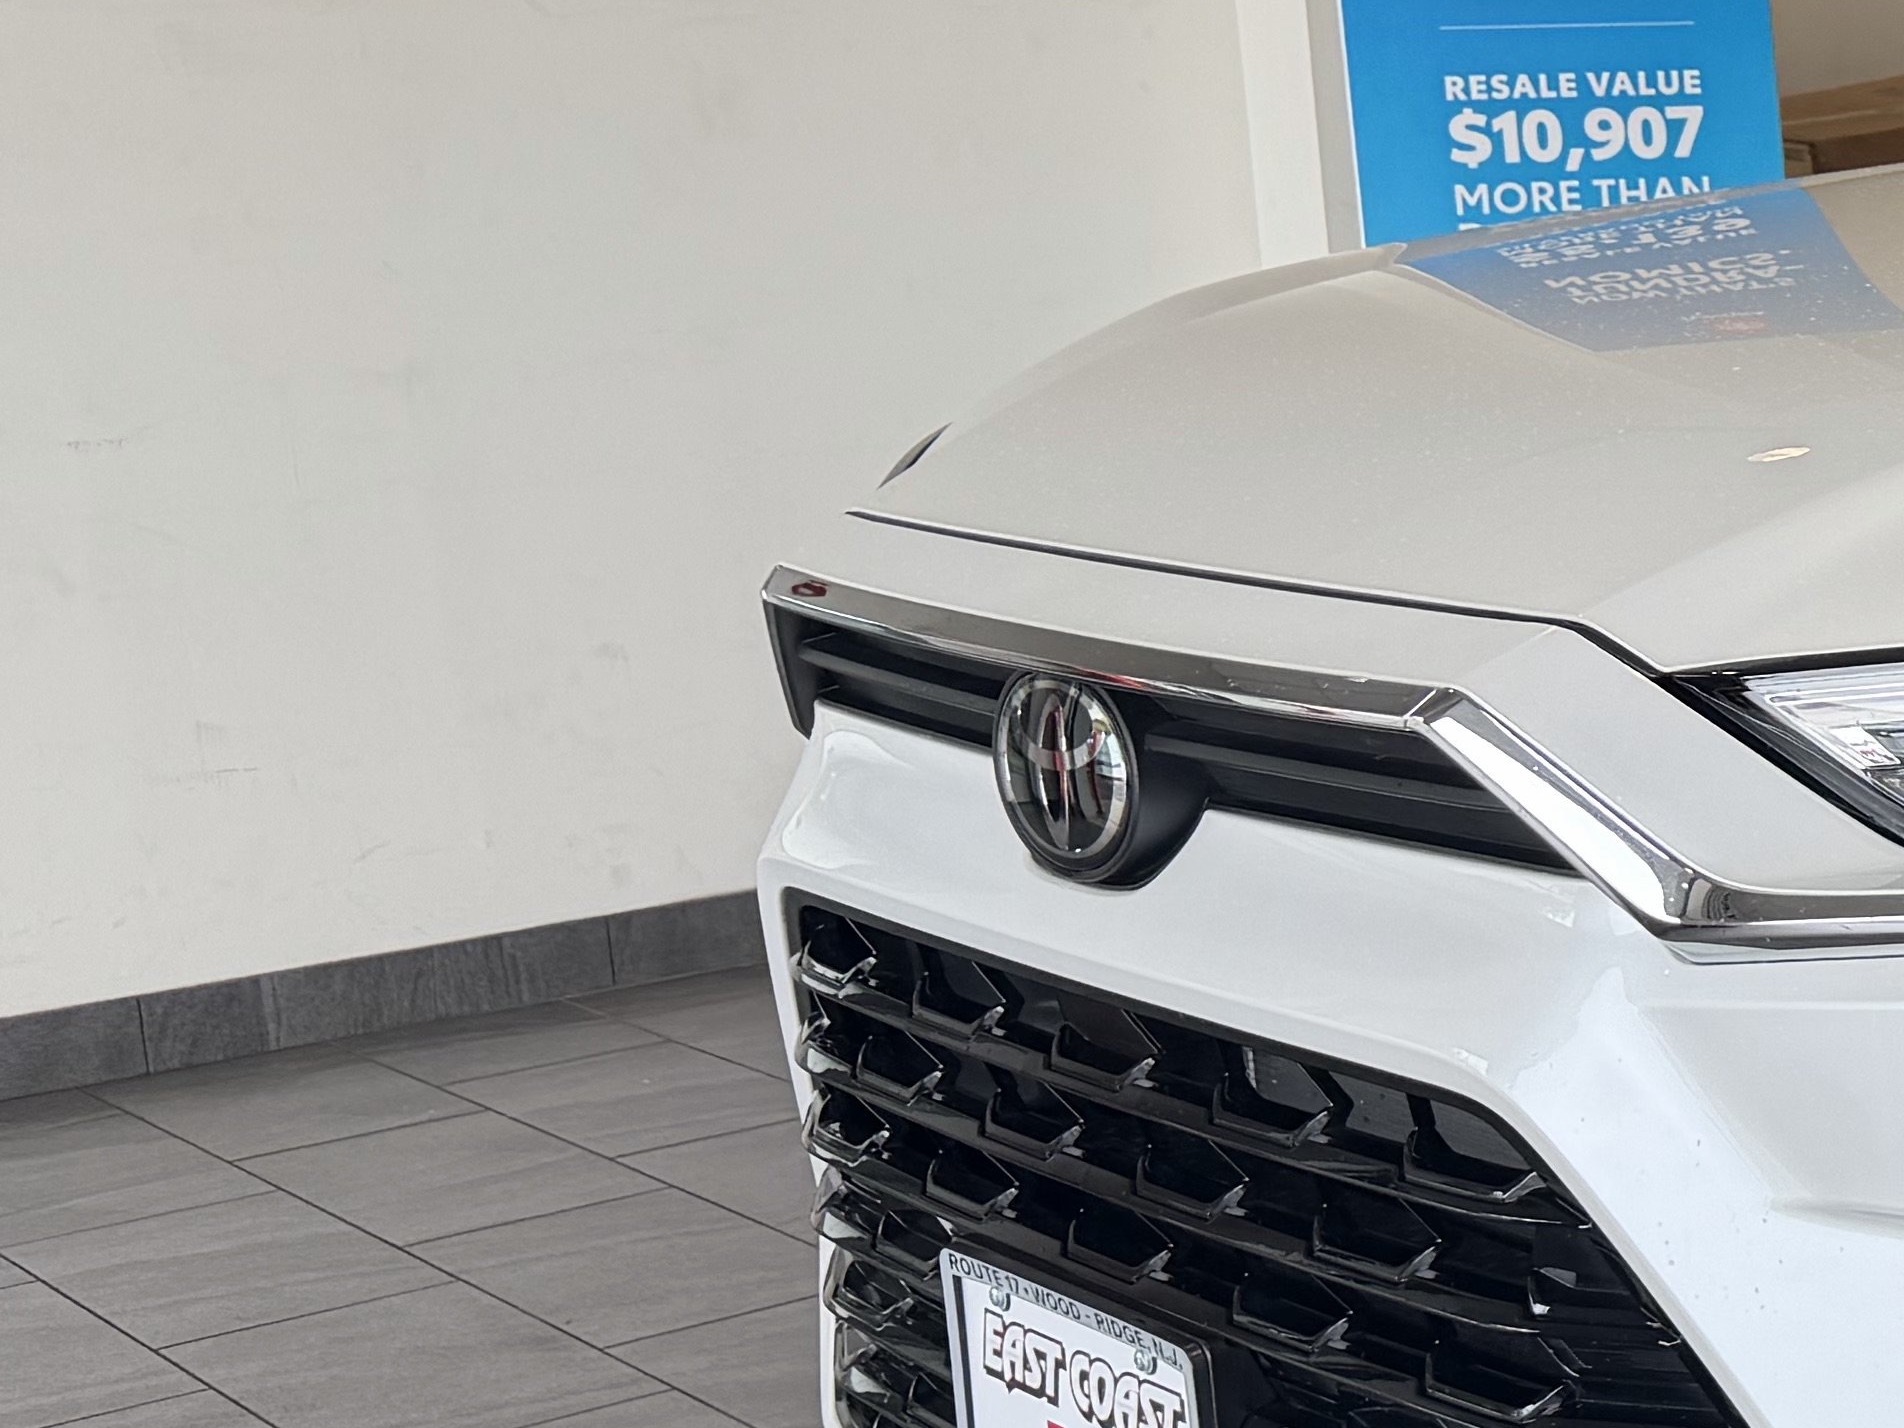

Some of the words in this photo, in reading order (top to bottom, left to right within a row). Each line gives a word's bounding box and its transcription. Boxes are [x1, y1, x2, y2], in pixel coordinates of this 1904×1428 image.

[1444, 73, 1579, 102] RESALE
[1587, 69, 1703, 97] VALUE
[1448, 105, 1705, 173] $10,907
[1454, 180, 1583, 217] MORE
[1592, 175, 1711, 208] THAN
[948, 1252, 1004, 1288] ROUTE
[1005, 1275, 1020, 1295] 17
[1031, 1286, 1081, 1321] WOOD
[984, 1308, 1067, 1408] EAST
